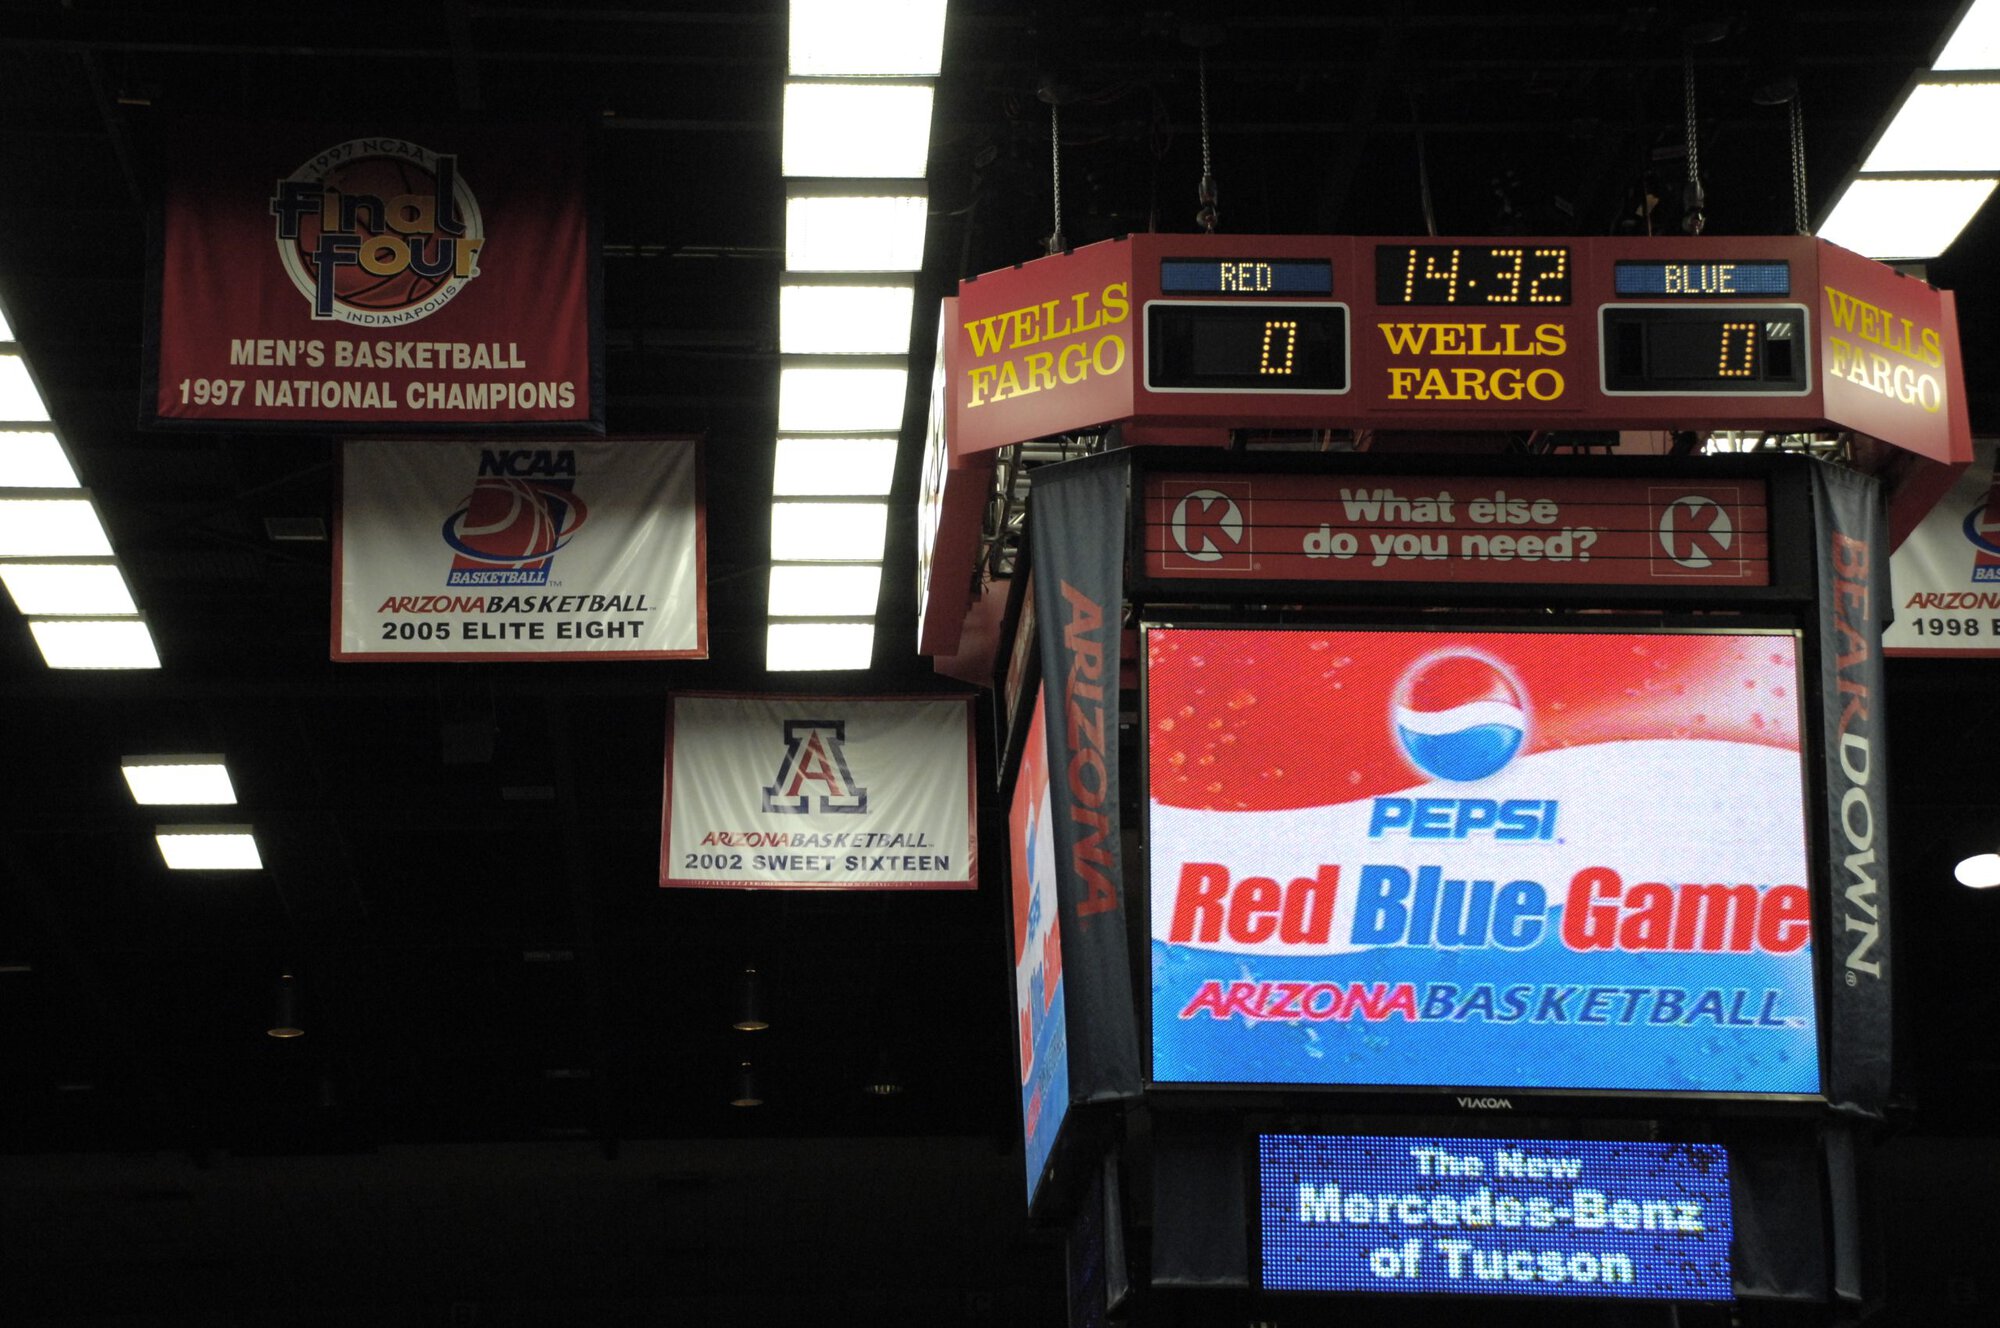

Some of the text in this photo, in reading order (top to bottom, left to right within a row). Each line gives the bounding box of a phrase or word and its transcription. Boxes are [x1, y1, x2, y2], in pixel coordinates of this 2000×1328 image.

[308, 139, 424, 174] 1997 NCAA
[1219, 262, 1273, 292] RED
[1663, 264, 1738, 294] BLUE
[346, 284, 457, 325] INDIANAPOLIS
[963, 281, 1131, 358] WELLS
[1377, 322, 1567, 356] WELLS
[1823, 286, 1943, 369] WELLS
[229, 338, 526, 369] MEN'S BASKETBALL
[1259, 321, 1298, 375] 0
[1717, 322, 1757, 377] 0
[966, 334, 1126, 409] FARGO
[1387, 367, 1566, 401] FARGO
[1828, 337, 1941, 414] FARGO
[179, 378, 576, 410] 1997 NATIONAL CHAMPIONS
[478, 449, 577, 477] NCAA
[1340, 488, 1559, 525] What else
[1302, 523, 1599, 567] do you need?
[450, 571, 546, 584] BASKETBALL
[1904, 592, 2000, 610] ARIZON
[382, 620, 645, 640] 2005 ELITE EIGHT
[1911, 617, 1980, 637] 1998
[1060, 578, 1119, 918] ARIZONA
[761, 719, 868, 814] A
[1367, 797, 1559, 841] PEPSI
[685, 853, 950, 871] 2002 SWEET SIXTEEN
[1168, 861, 1811, 954] Red Blue Game
[1457, 1097, 1512, 1110] VIACOM
[1410, 1145, 1583, 1179] The New
[1299, 1182, 1705, 1232] Mercedes-Benz
[1369, 1238, 1638, 1284] of Tucson
